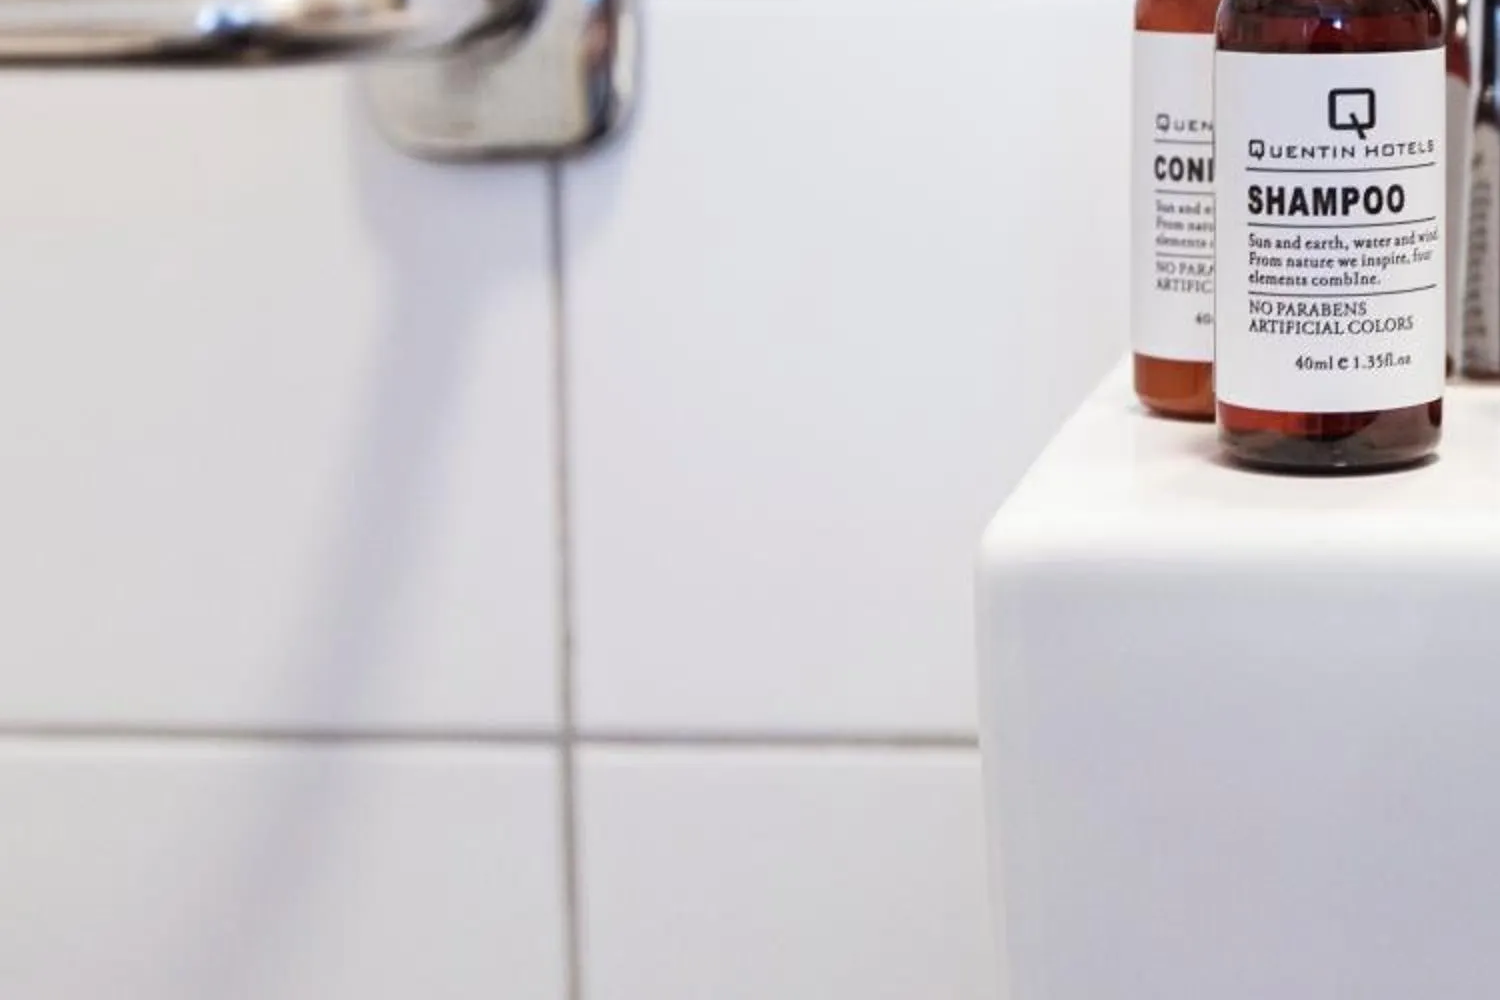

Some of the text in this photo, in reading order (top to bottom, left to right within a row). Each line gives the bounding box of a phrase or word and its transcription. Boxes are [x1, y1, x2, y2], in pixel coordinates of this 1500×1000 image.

[1248, 139, 1435, 160] QUENTIN HOTELS
[1248, 184, 1405, 216] SHAMPOO
[1248, 232, 1273, 249] Sun
[1275, 235, 1301, 249] and
[1353, 237, 1392, 249] water
[1394, 230, 1416, 246] and
[1156, 260, 1176, 275] NO
[1249, 251, 1282, 267] From
[1286, 257, 1335, 269] nature
[1338, 257, 1358, 268] we
[1248, 269, 1307, 287] elements
[1249, 299, 1367, 317] NO PARABENS
[1248, 315, 1414, 335] ARTIFICIAL COLORS
[1295, 355, 1333, 370] 40ml
